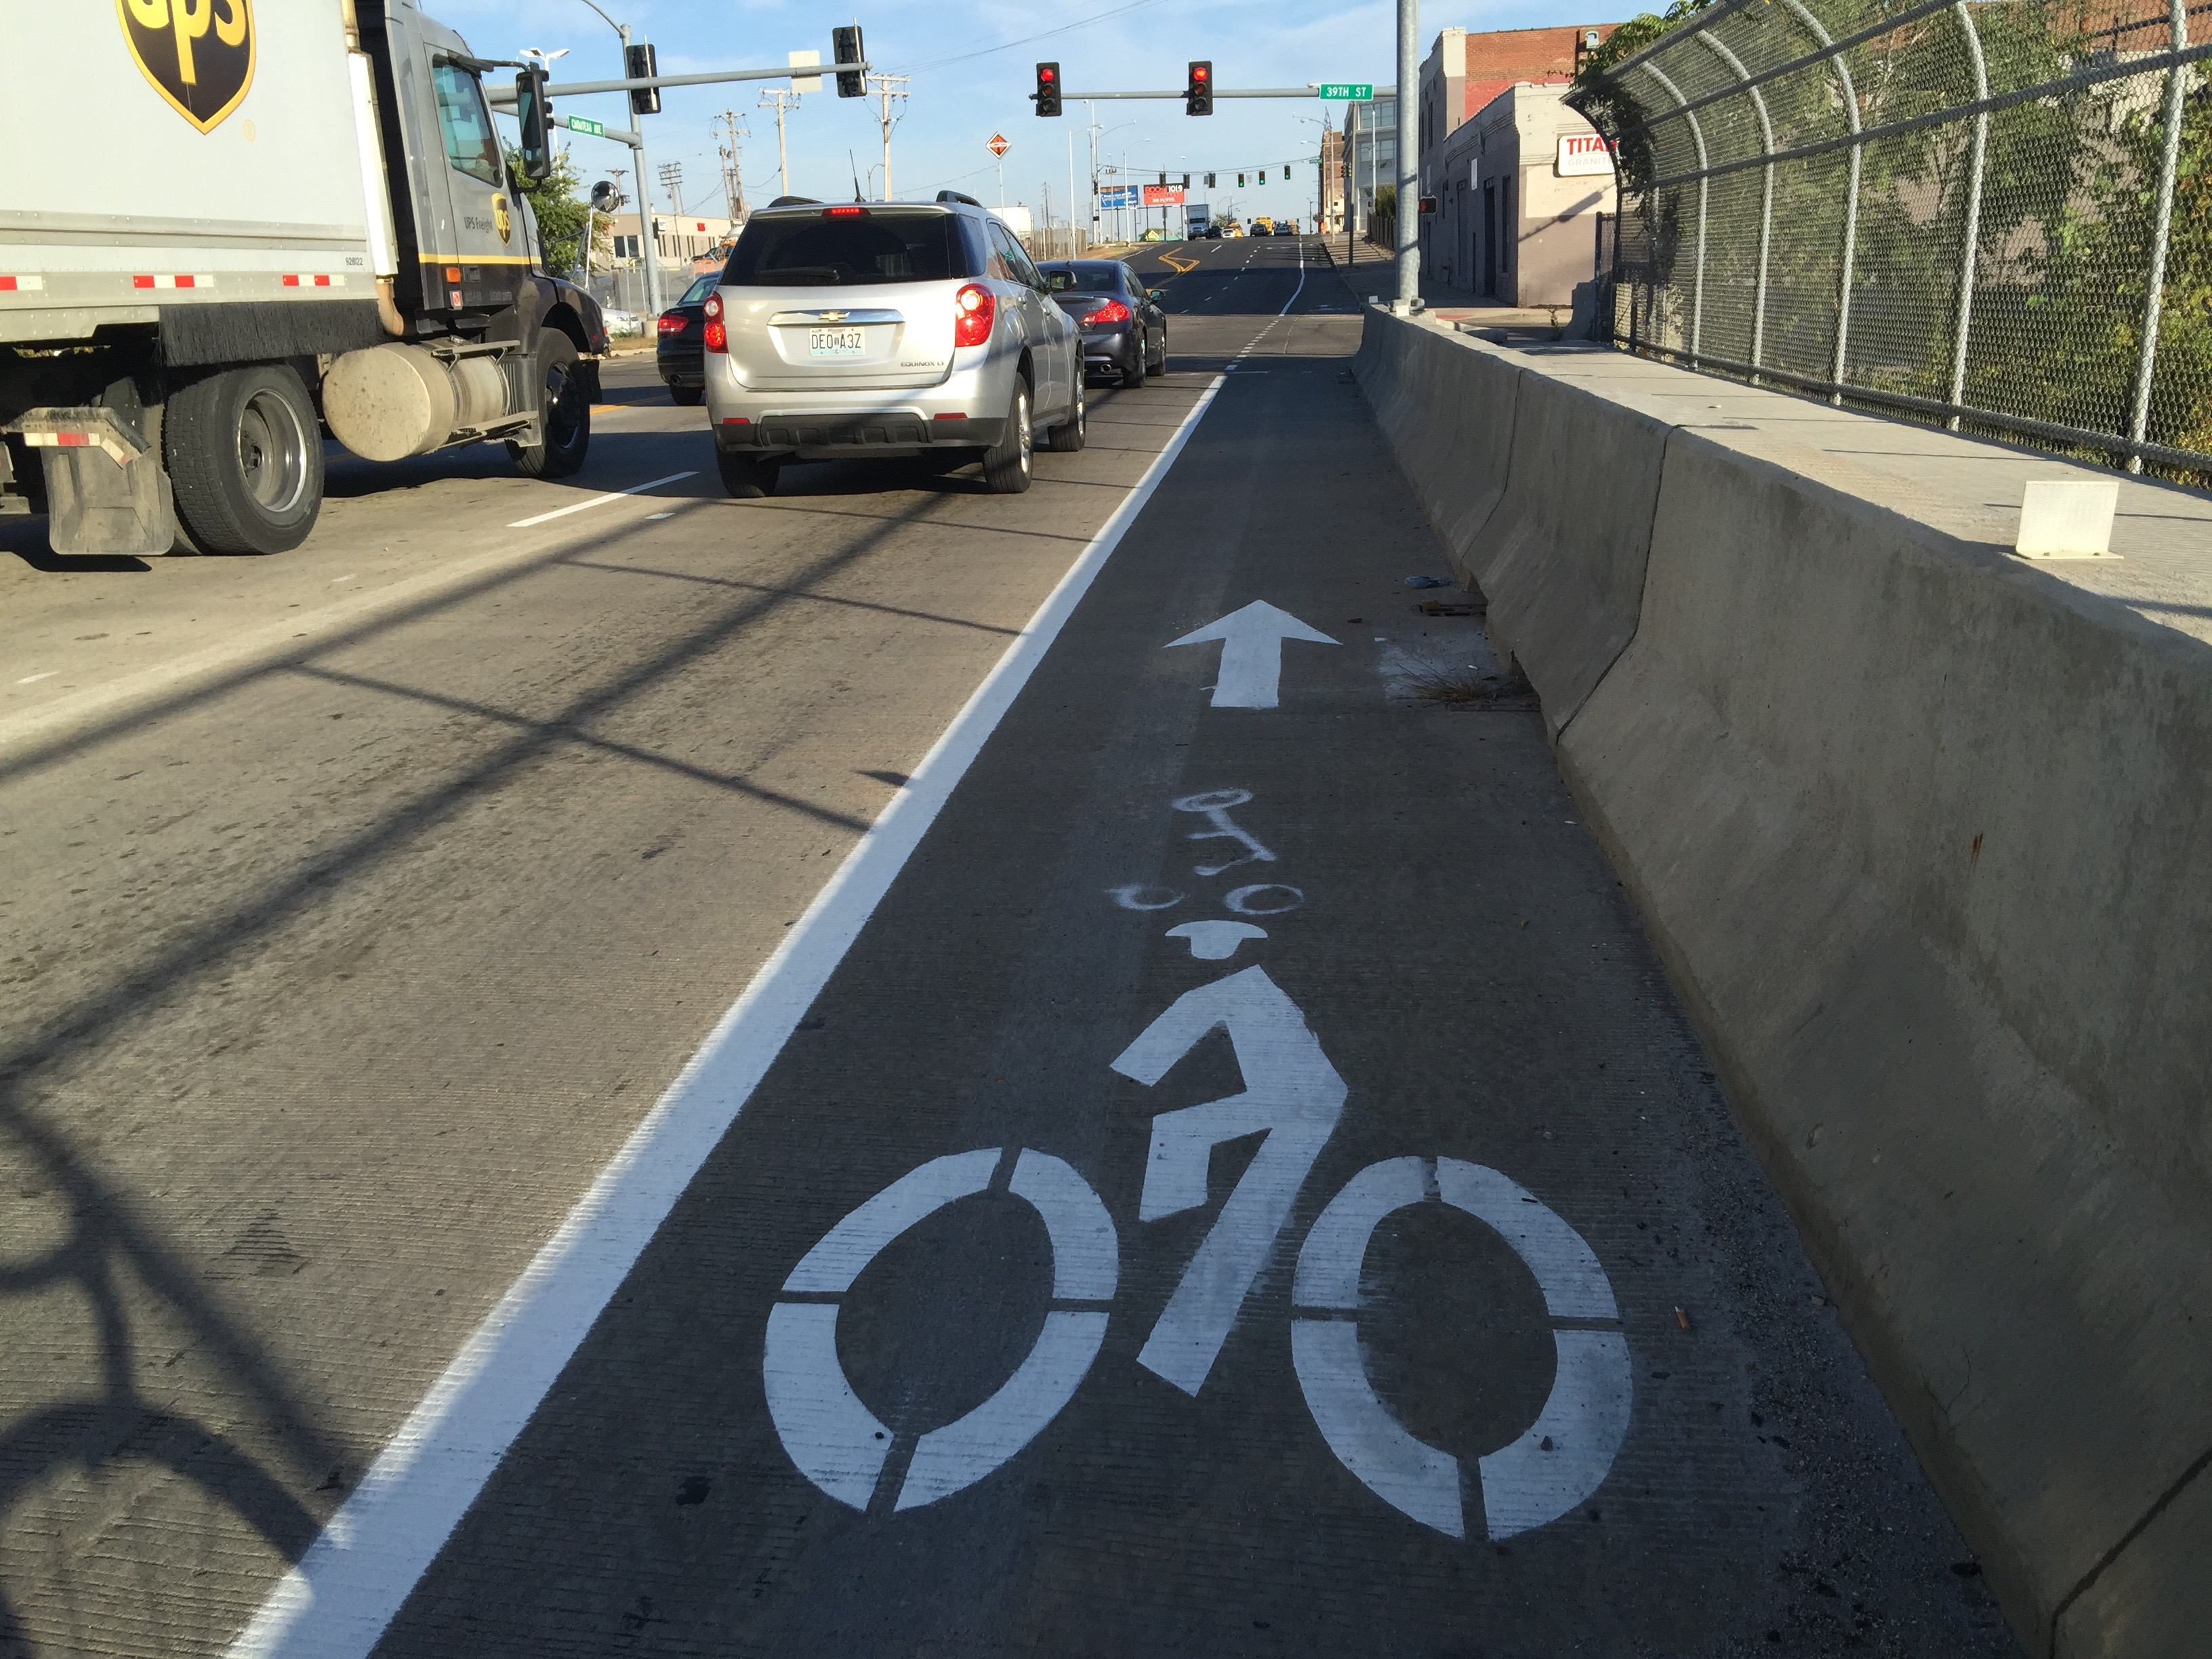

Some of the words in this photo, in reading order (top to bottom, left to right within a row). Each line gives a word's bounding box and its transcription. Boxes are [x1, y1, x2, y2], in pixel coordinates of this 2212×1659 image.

[1326, 86, 1349, 97] 39TH
[1355, 86, 1366, 97] ST
[464, 216, 475, 229] UPS
[475, 217, 493, 234] Freight
[840, 333, 861, 348] A3Z
